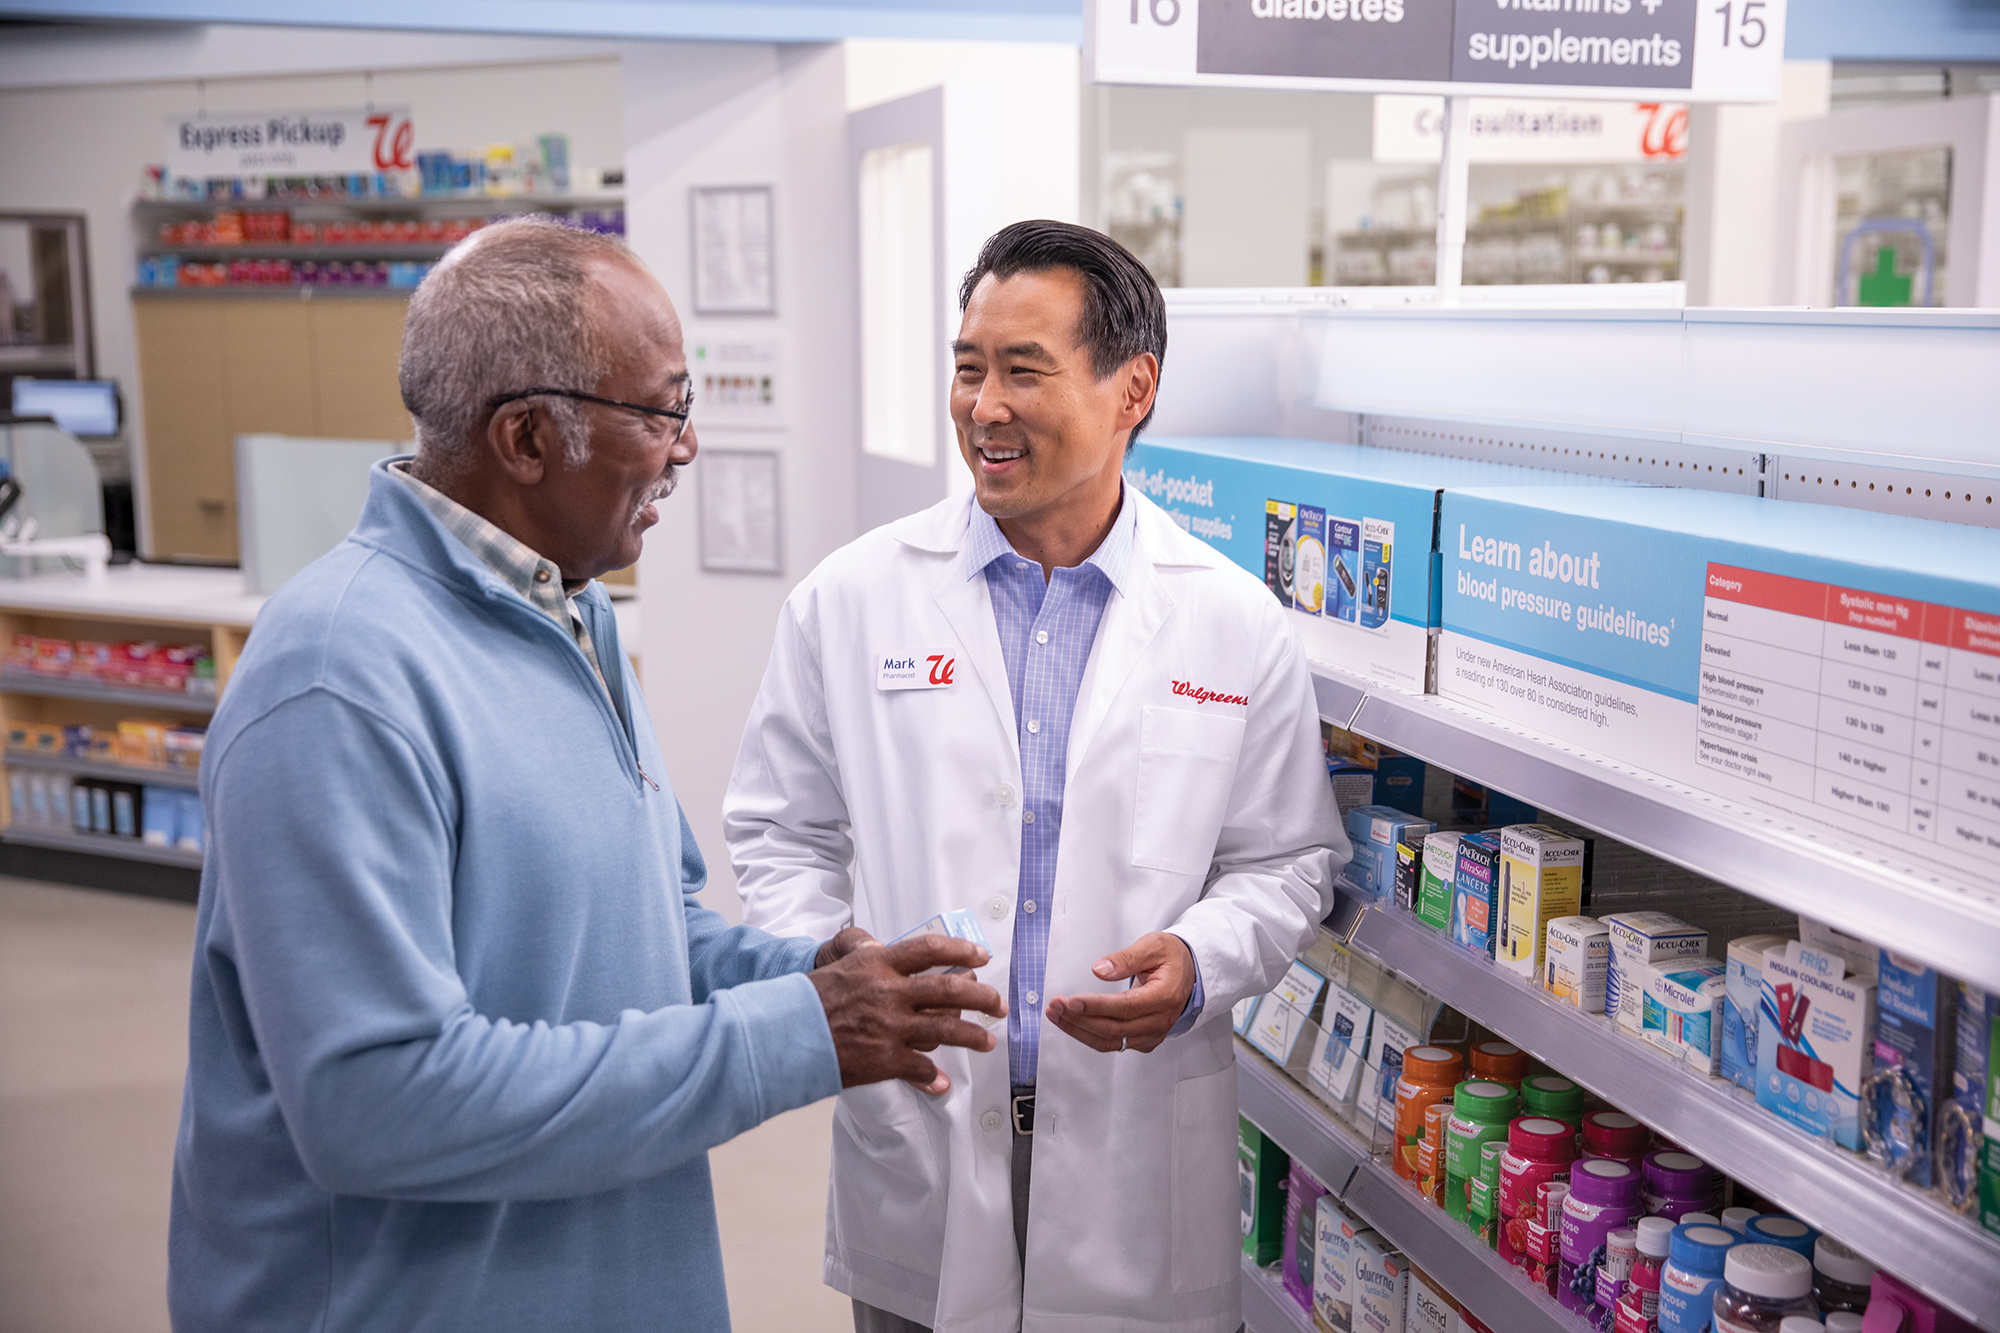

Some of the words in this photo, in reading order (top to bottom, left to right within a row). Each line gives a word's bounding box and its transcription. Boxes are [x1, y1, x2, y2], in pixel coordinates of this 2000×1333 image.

[1714, 1, 1767, 49] 15
[1467, 28, 1683, 69] supplements
[1414, 108, 1603, 137] Cosultation
[179, 122, 262, 154] Express
[266, 116, 346, 149] Pickup
[1458, 523, 1521, 572] Learn
[1529, 540, 1600, 590] about
[1709, 574, 1743, 592] Category
[1457, 569, 1497, 603] blood
[1501, 586, 1571, 622] pressure
[1840, 593, 1875, 612] Systolic
[1876, 601, 1894, 615] mm
[1895, 604, 1910, 620] Hg
[1706, 609, 1729, 623] Normal
[1704, 643, 1731, 658] Elevated
[1843, 639, 1863, 652] Less
[1863, 642, 1881, 656] than
[1881, 646, 1897, 660] 120
[883, 657, 916, 670] Mark
[1925, 658, 1941, 671] and
[1455, 646, 1477, 667] Under
[1477, 652, 1492, 670] new
[1492, 658, 1526, 681] American
[1526, 668, 1547, 689] Heart
[1547, 675, 1593, 702] Association
[1594, 686, 1639, 719] guidelines,
[1702, 671, 1717, 685] High
[1717, 674, 1735, 688] blood
[1735, 680, 1764, 696] pressure
[1847, 679, 1861, 692] 120
[1863, 684, 1872, 694] to
[1974, 669, 1994, 683] Less
[1171, 679, 1249, 706] Walgreens
[1455, 667, 1461, 677] a
[1461, 667, 1486, 689] reading
[1487, 675, 1495, 688] of
[1495, 678, 1509, 694] 130
[1510, 684, 1526, 698] over
[1527, 687, 1537, 702] 80
[1537, 690, 1545, 705] is
[1545, 693, 1589, 719] considered
[1589, 706, 1610, 729] high.
[1702, 683, 1738, 702] Hypertension
[1738, 694, 1754, 707] stage
[1922, 697, 1938, 710] and
[1701, 704, 1715, 718] High
[1715, 708, 1733, 723] blood
[1734, 714, 1763, 730] pressure
[1845, 716, 1860, 729] 130
[1860, 720, 1868, 730] to
[1970, 708, 1991, 723] Less
[1700, 716, 1737, 737] Hypertension
[1738, 728, 1752, 742] stage
[1699, 738, 1740, 760] Hypertensive
[1740, 751, 1758, 765] crisis
[1922, 737, 1932, 747] or
[1698, 749, 1709, 762] See
[1709, 755, 1723, 769] your
[1723, 756, 1742, 773] doctor
[1742, 763, 1757, 780] right
[1756, 769, 1773, 784] away
[1838, 752, 1852, 765] 140
[1853, 756, 1861, 766] or
[1862, 758, 1887, 774] higher
[1919, 776, 1929, 786] or
[1831, 786, 1856, 803] Higher
[1856, 792, 1875, 808] than
[1875, 798, 1890, 813] 180
[1917, 822, 1927, 832] or
[1956, 826, 1985, 843] Higher
[1502, 834, 1536, 856] ACCU-CHEK
[1543, 848, 1581, 858] ACCU-CHEK
[1460, 859, 1490, 880] UltraSoft
[1456, 871, 1489, 894] LANCETS
[1548, 926, 1580, 949] ACCU-CHEK
[1611, 924, 1645, 947] ACCU-CHEK
[1654, 939, 1701, 950] ACCU-CHEK
[1769, 960, 1799, 979] INSULIN
[1800, 972, 1834, 993] COOLING
[1835, 986, 1856, 1002] CASE
[1663, 982, 1696, 1008] Microlet
[1355, 1257, 1394, 1293] Glucerna
[1417, 1292, 1447, 1328] Extend
